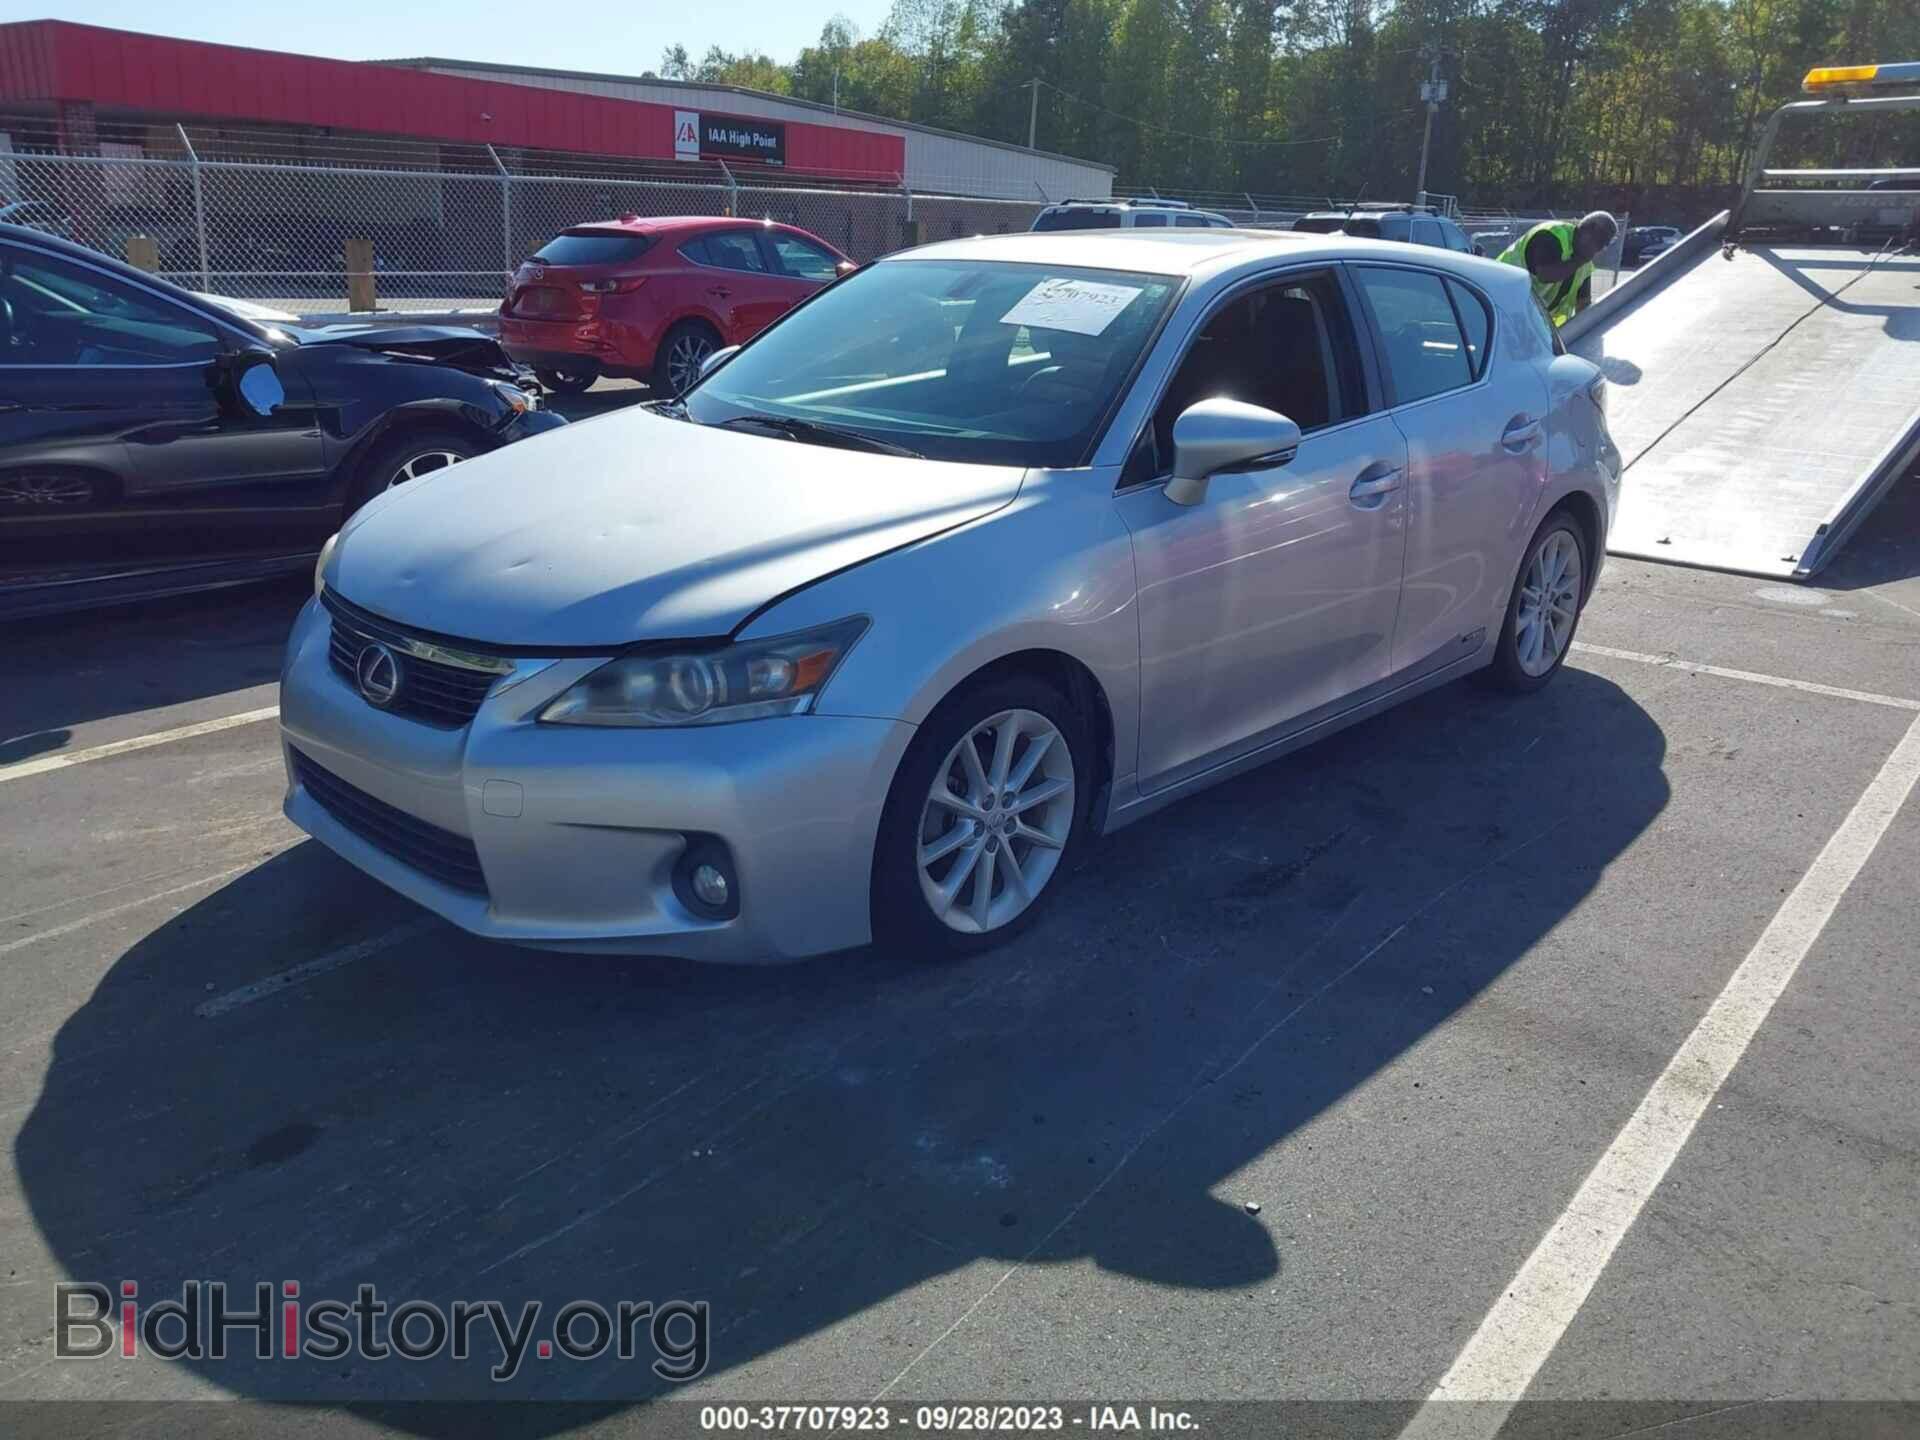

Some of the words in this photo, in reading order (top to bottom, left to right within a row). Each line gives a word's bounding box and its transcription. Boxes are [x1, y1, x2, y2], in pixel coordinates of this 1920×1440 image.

[708, 128, 727, 143] IAA
[729, 130, 751, 148] High
[753, 133, 776, 148] Point
